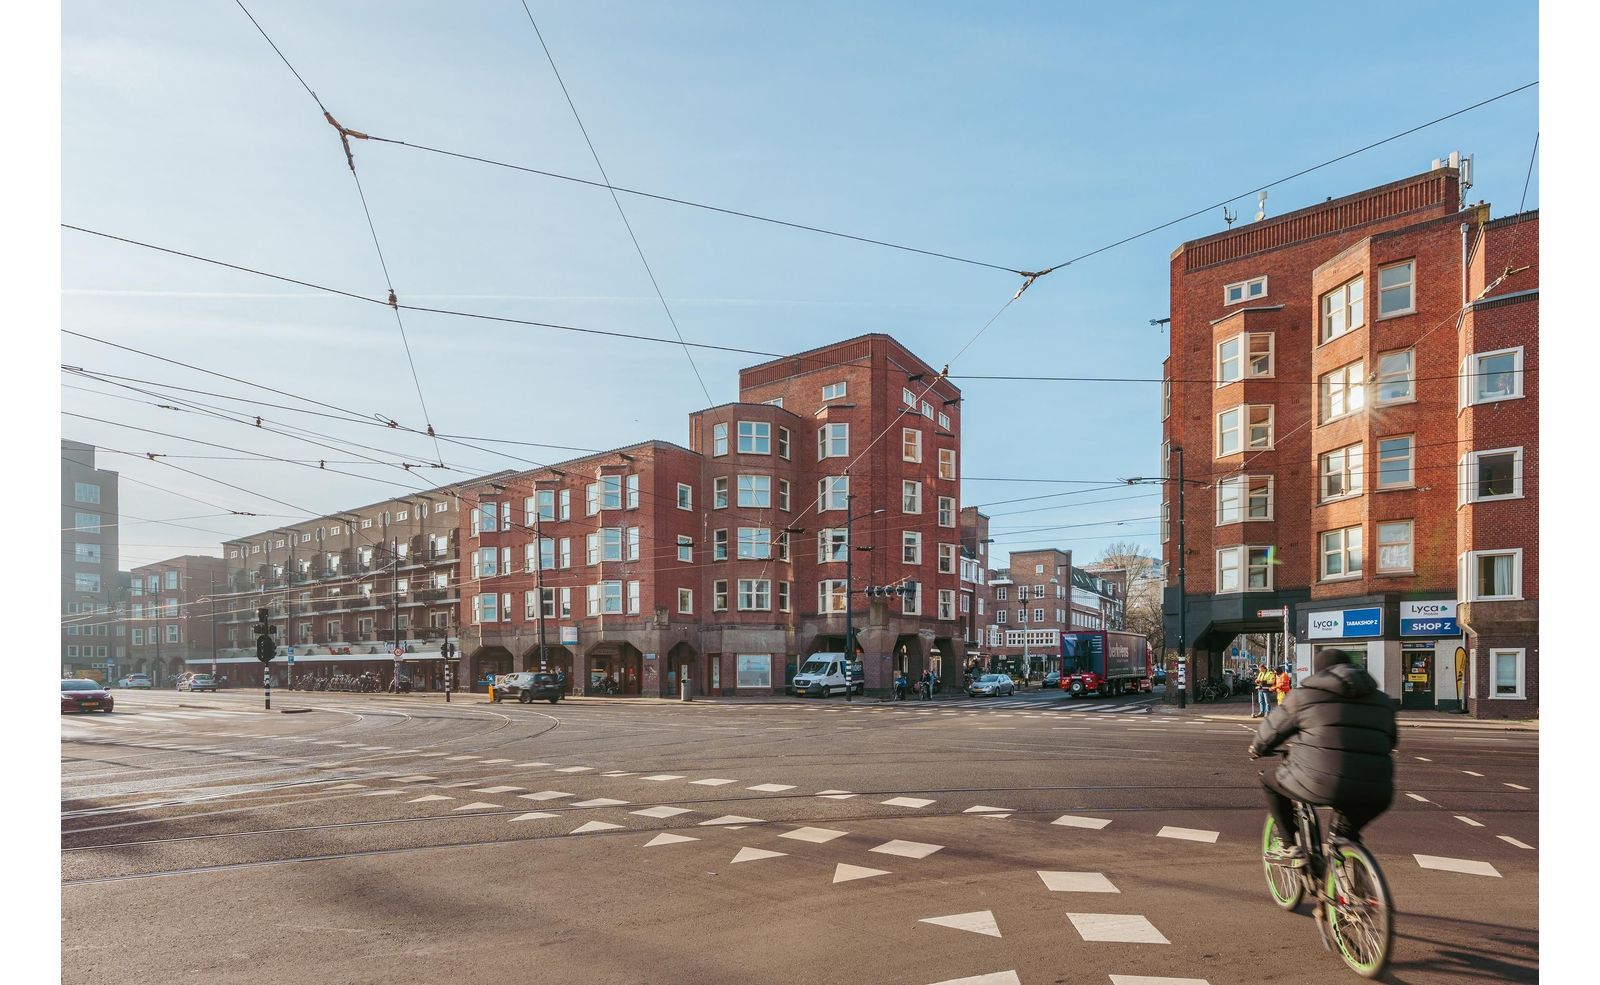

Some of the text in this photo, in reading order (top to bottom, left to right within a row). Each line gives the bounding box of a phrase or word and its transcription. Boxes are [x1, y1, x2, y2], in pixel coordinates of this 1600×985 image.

[1411, 605, 1439, 614] Lyca
[1313, 620, 1333, 629] Lyca
[1412, 622, 1451, 631] SHOP Z
